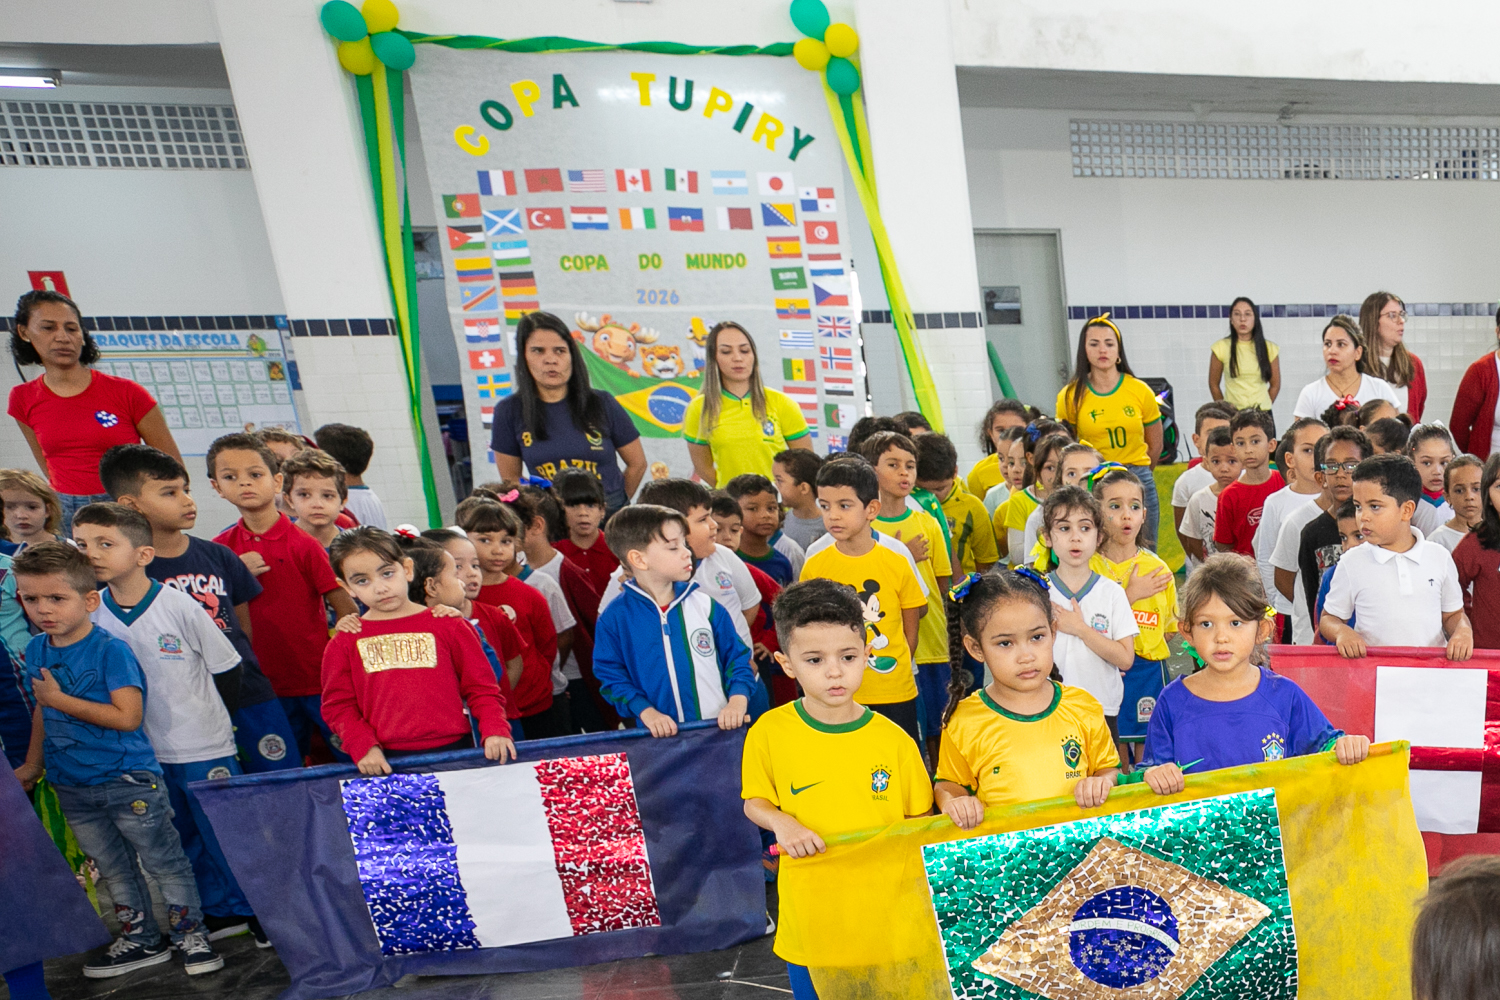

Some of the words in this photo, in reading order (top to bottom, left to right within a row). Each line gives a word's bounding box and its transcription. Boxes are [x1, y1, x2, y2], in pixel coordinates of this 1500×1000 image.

[454, 73, 580, 157] COPA
[630, 71, 815, 162] TUPIRY
[560, 253, 610, 272] COPA
[638, 252, 662, 270] DO
[685, 252, 747, 270] MUNDO
[636, 288, 680, 306] 2026
[158, 333, 182, 347] DA
[183, 333, 240, 346] ESCOLA
[522, 431, 533, 448] 8
[1105, 425, 1127, 449] 10
[165, 573, 228, 597] OPICAL
[392, 638, 430, 663] TOUR
[1073, 920, 1112, 930] ORDEM
[1116, 920, 1124, 929] E
[1127, 921, 1177, 950] PROGRESSO
